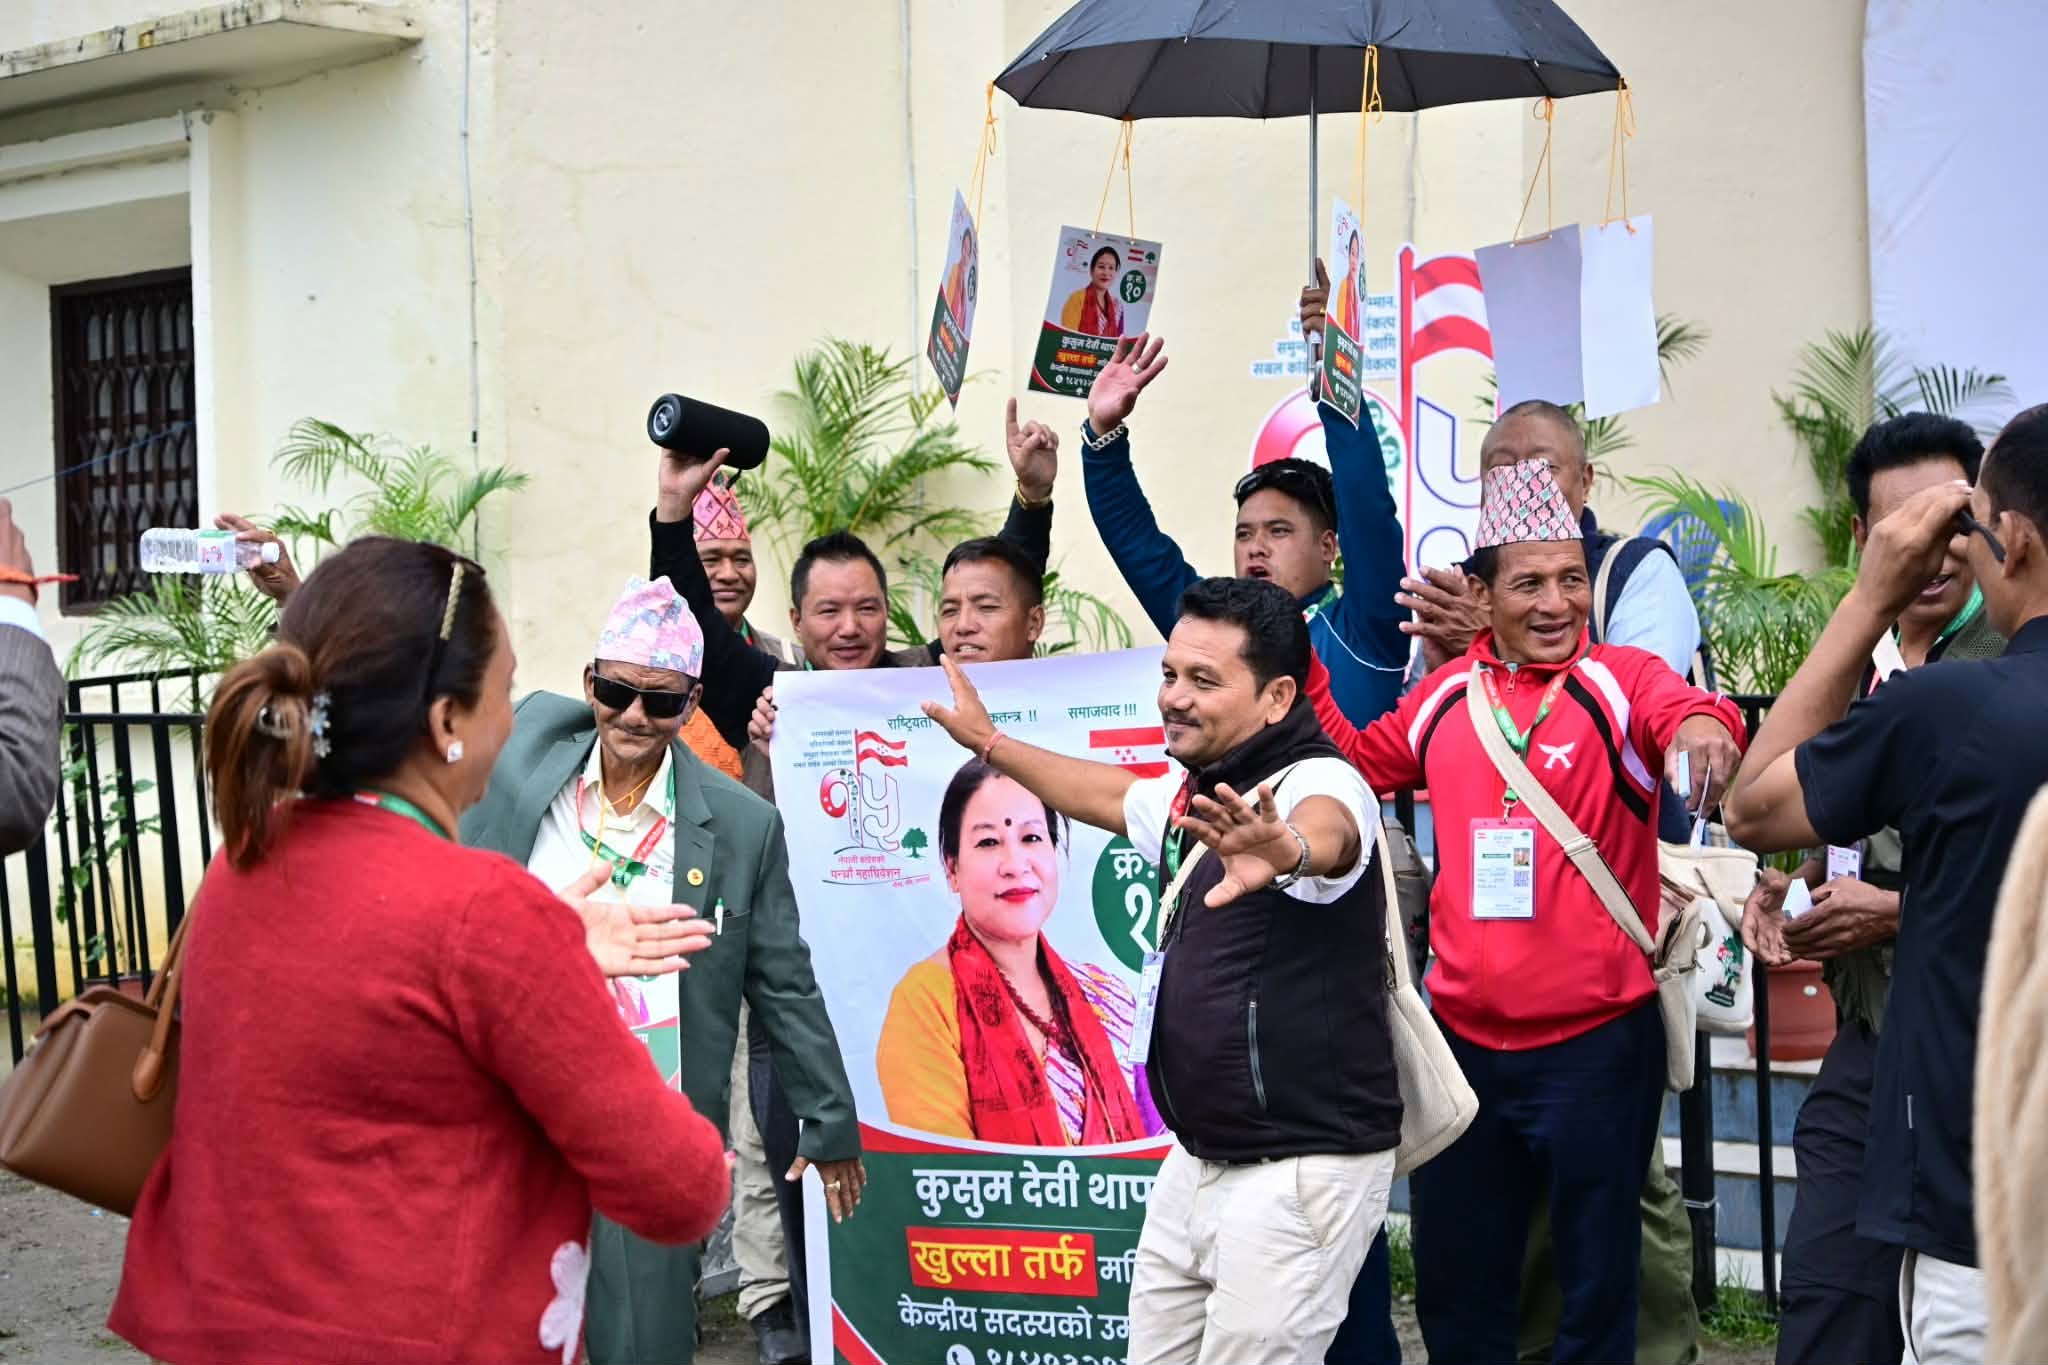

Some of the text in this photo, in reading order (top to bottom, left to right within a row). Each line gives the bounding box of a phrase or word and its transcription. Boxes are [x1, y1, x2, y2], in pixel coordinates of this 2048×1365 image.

[1067, 705, 1120, 719] समाजवाद
[912, 1160, 1157, 1218] कुसुम देवी थाप
[911, 1241, 1011, 1284] खुल्ला
[1020, 1234, 1085, 1280] तर्फ
[898, 1294, 977, 1332] केन्द्रीय
[981, 1305, 1092, 1340] सदस्यको
